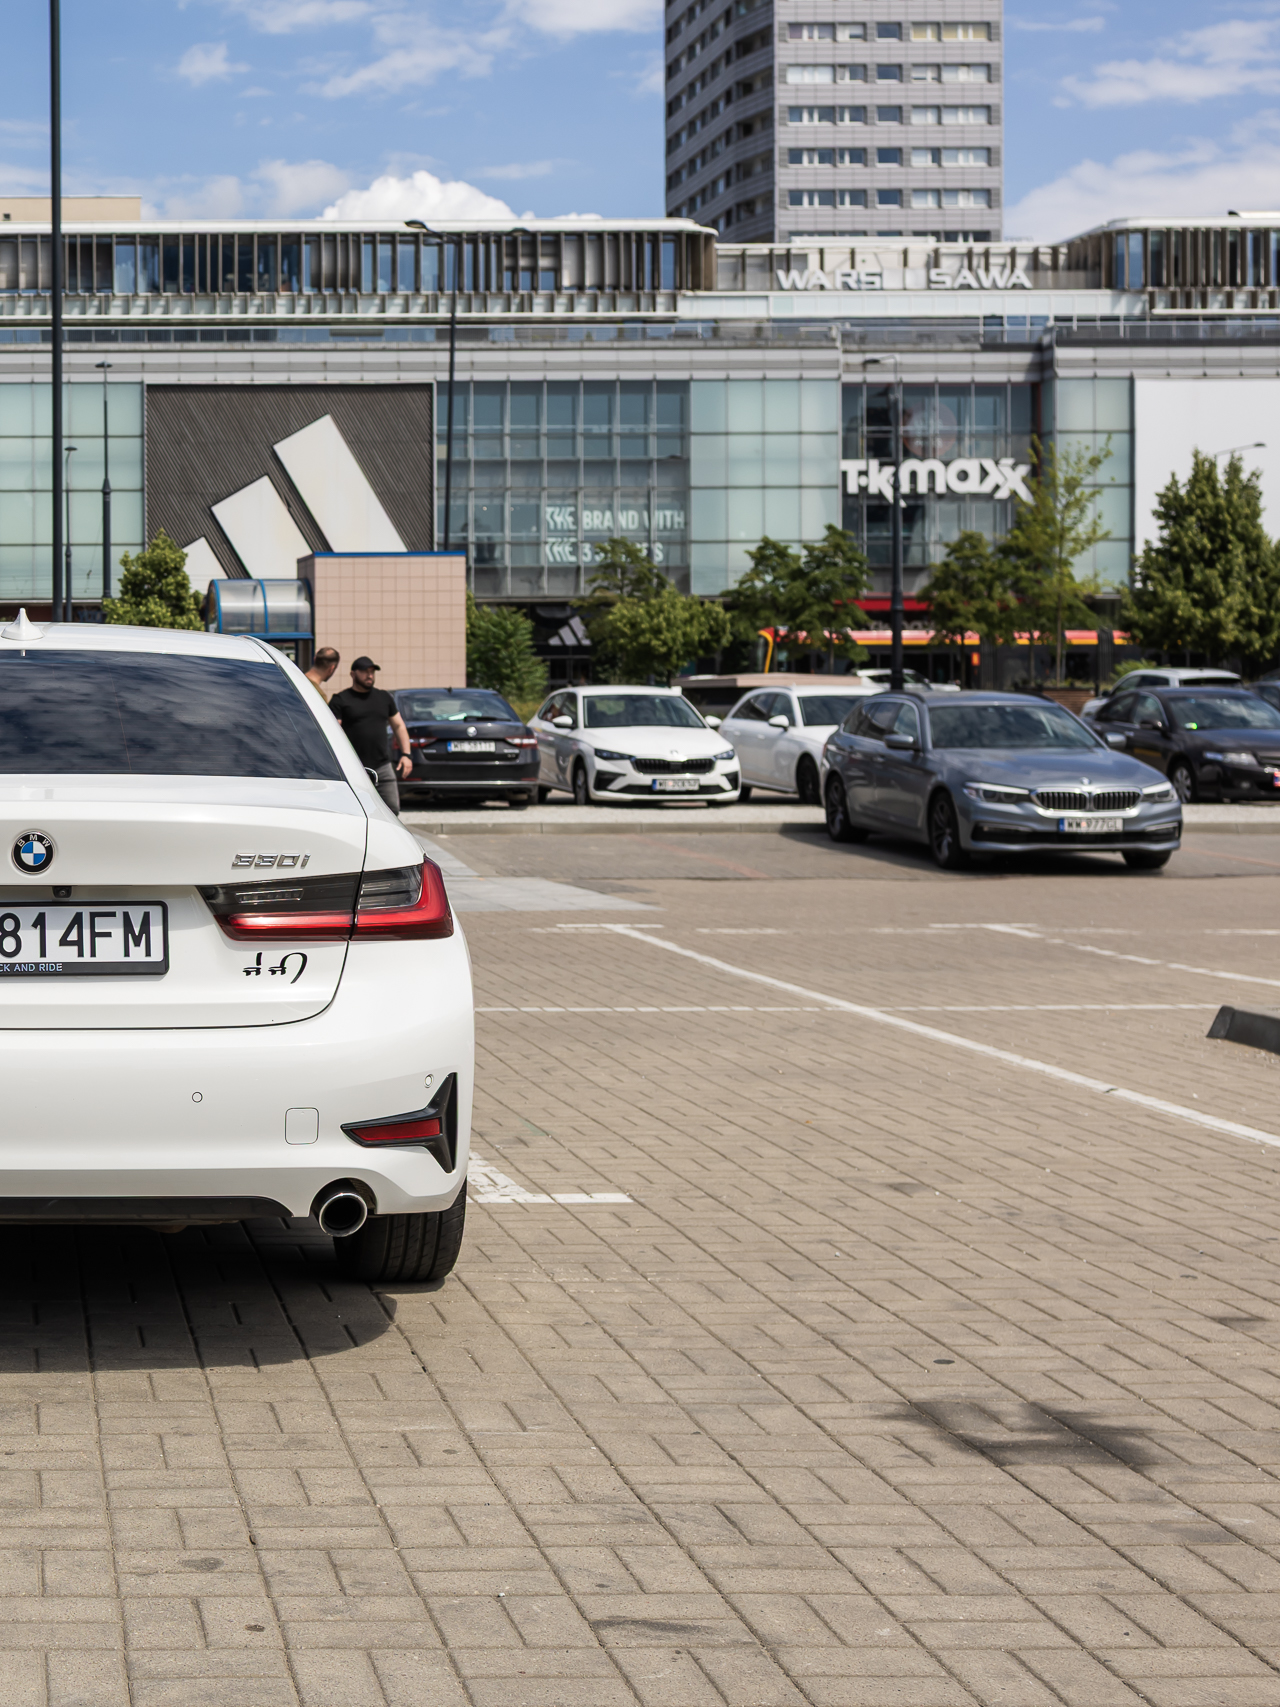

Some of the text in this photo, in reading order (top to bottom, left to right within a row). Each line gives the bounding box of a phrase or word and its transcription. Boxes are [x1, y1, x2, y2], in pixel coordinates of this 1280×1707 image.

[776, 268, 1033, 290] WARS SAWA
[546, 506, 578, 531] THE
[583, 510, 639, 530] BRAND
[546, 537, 578, 562] THE
[17, 834, 51, 847] BMW
[14, 964, 35, 973] AND
[39, 963, 63, 972] RIDE
